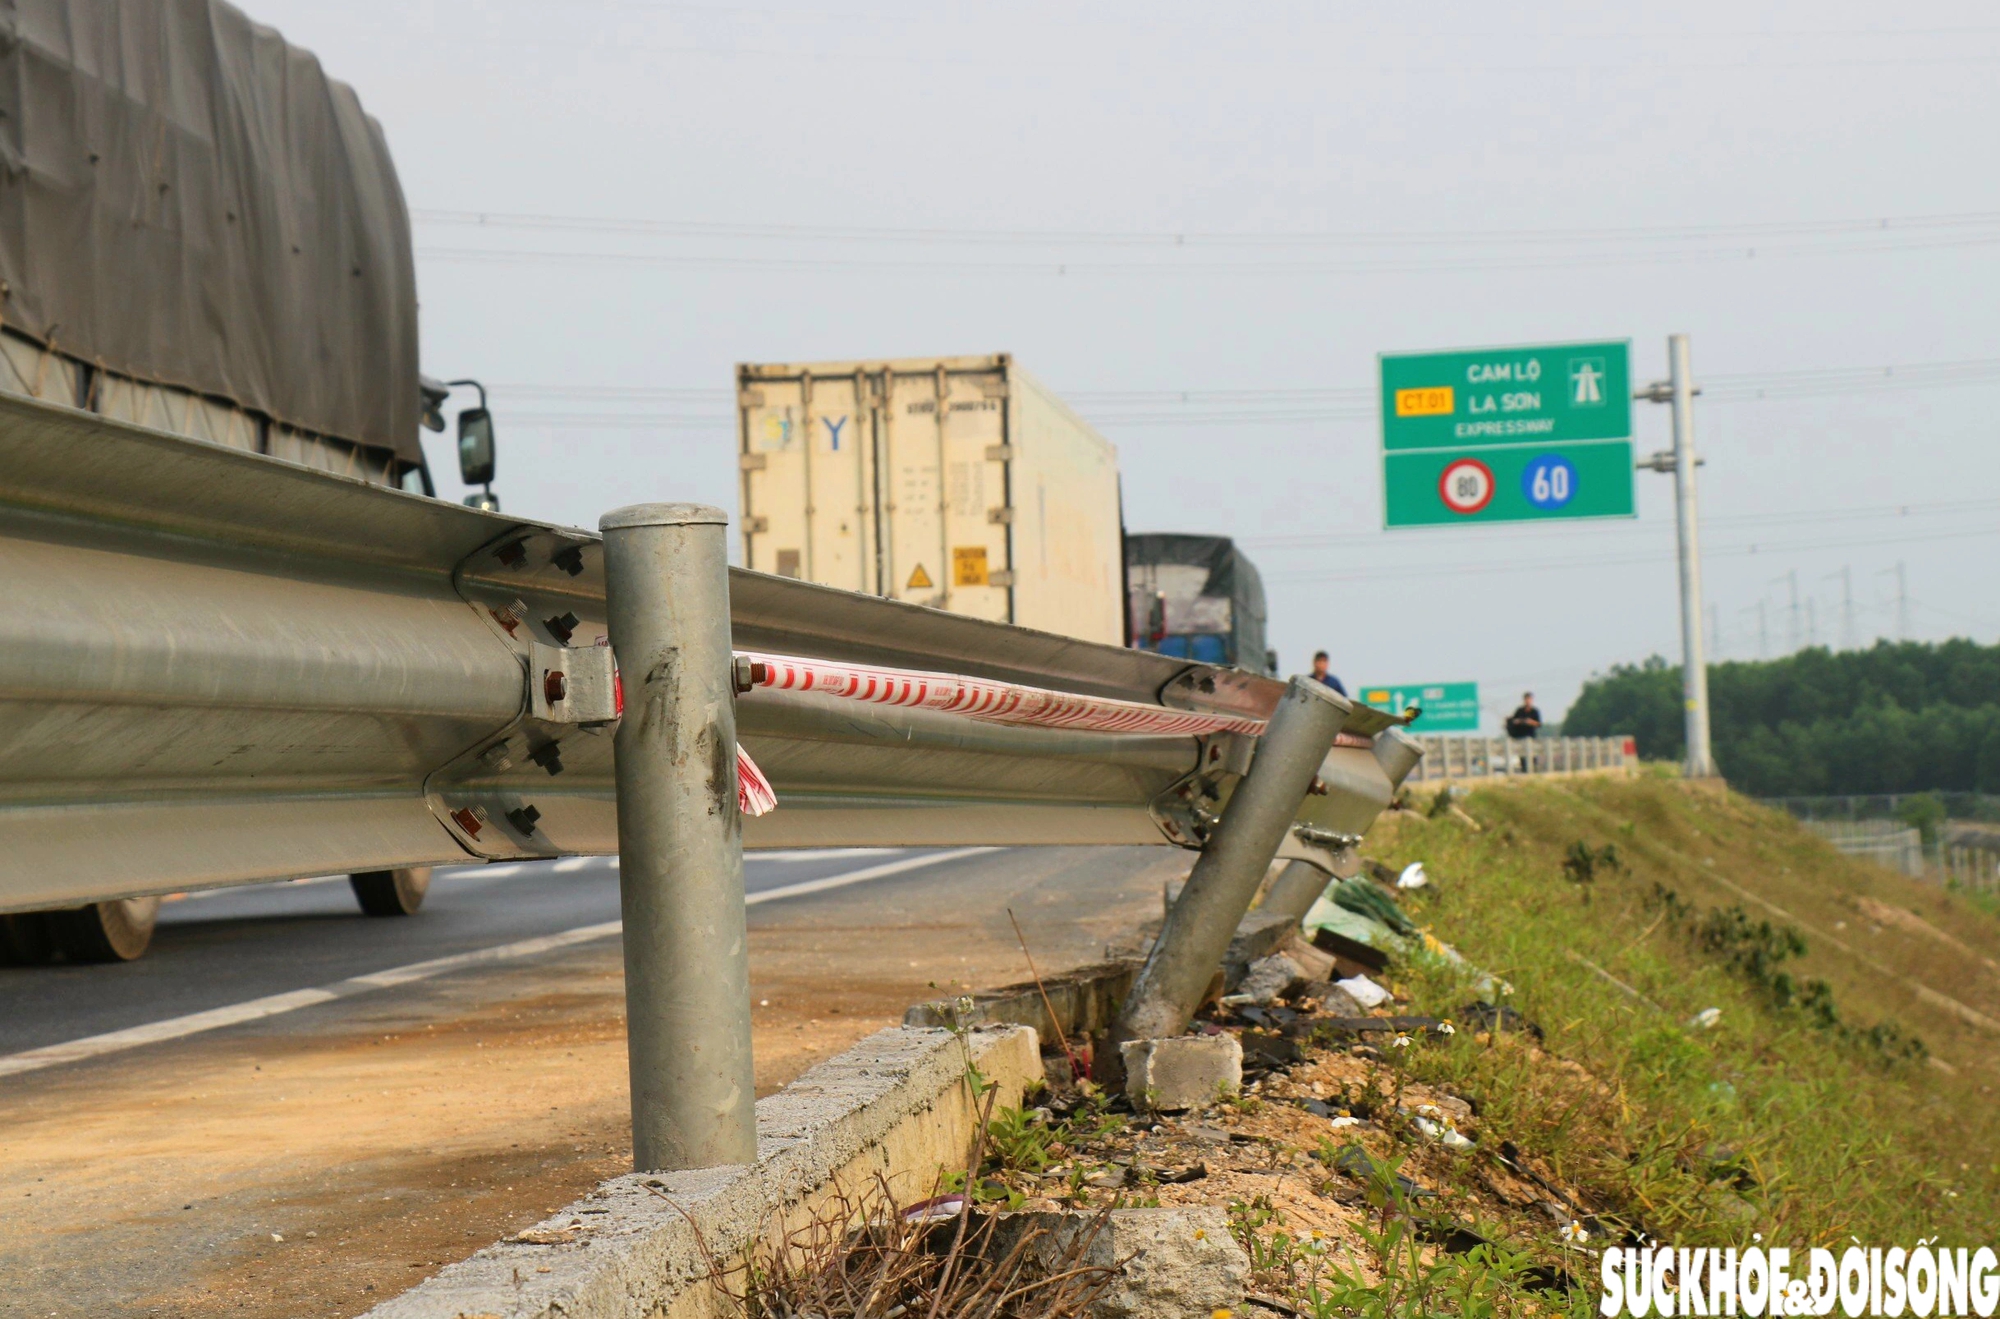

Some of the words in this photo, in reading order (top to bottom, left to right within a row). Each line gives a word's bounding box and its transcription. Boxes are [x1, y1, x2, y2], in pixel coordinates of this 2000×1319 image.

[1467, 363, 1511, 383] CAM
[1469, 394, 1498, 414] LA
[821, 414, 847, 451] Y
[1456, 419, 1553, 437] EXPRESSWAY
[1458, 477, 1478, 497] 80
[1533, 465, 1569, 501] 60
